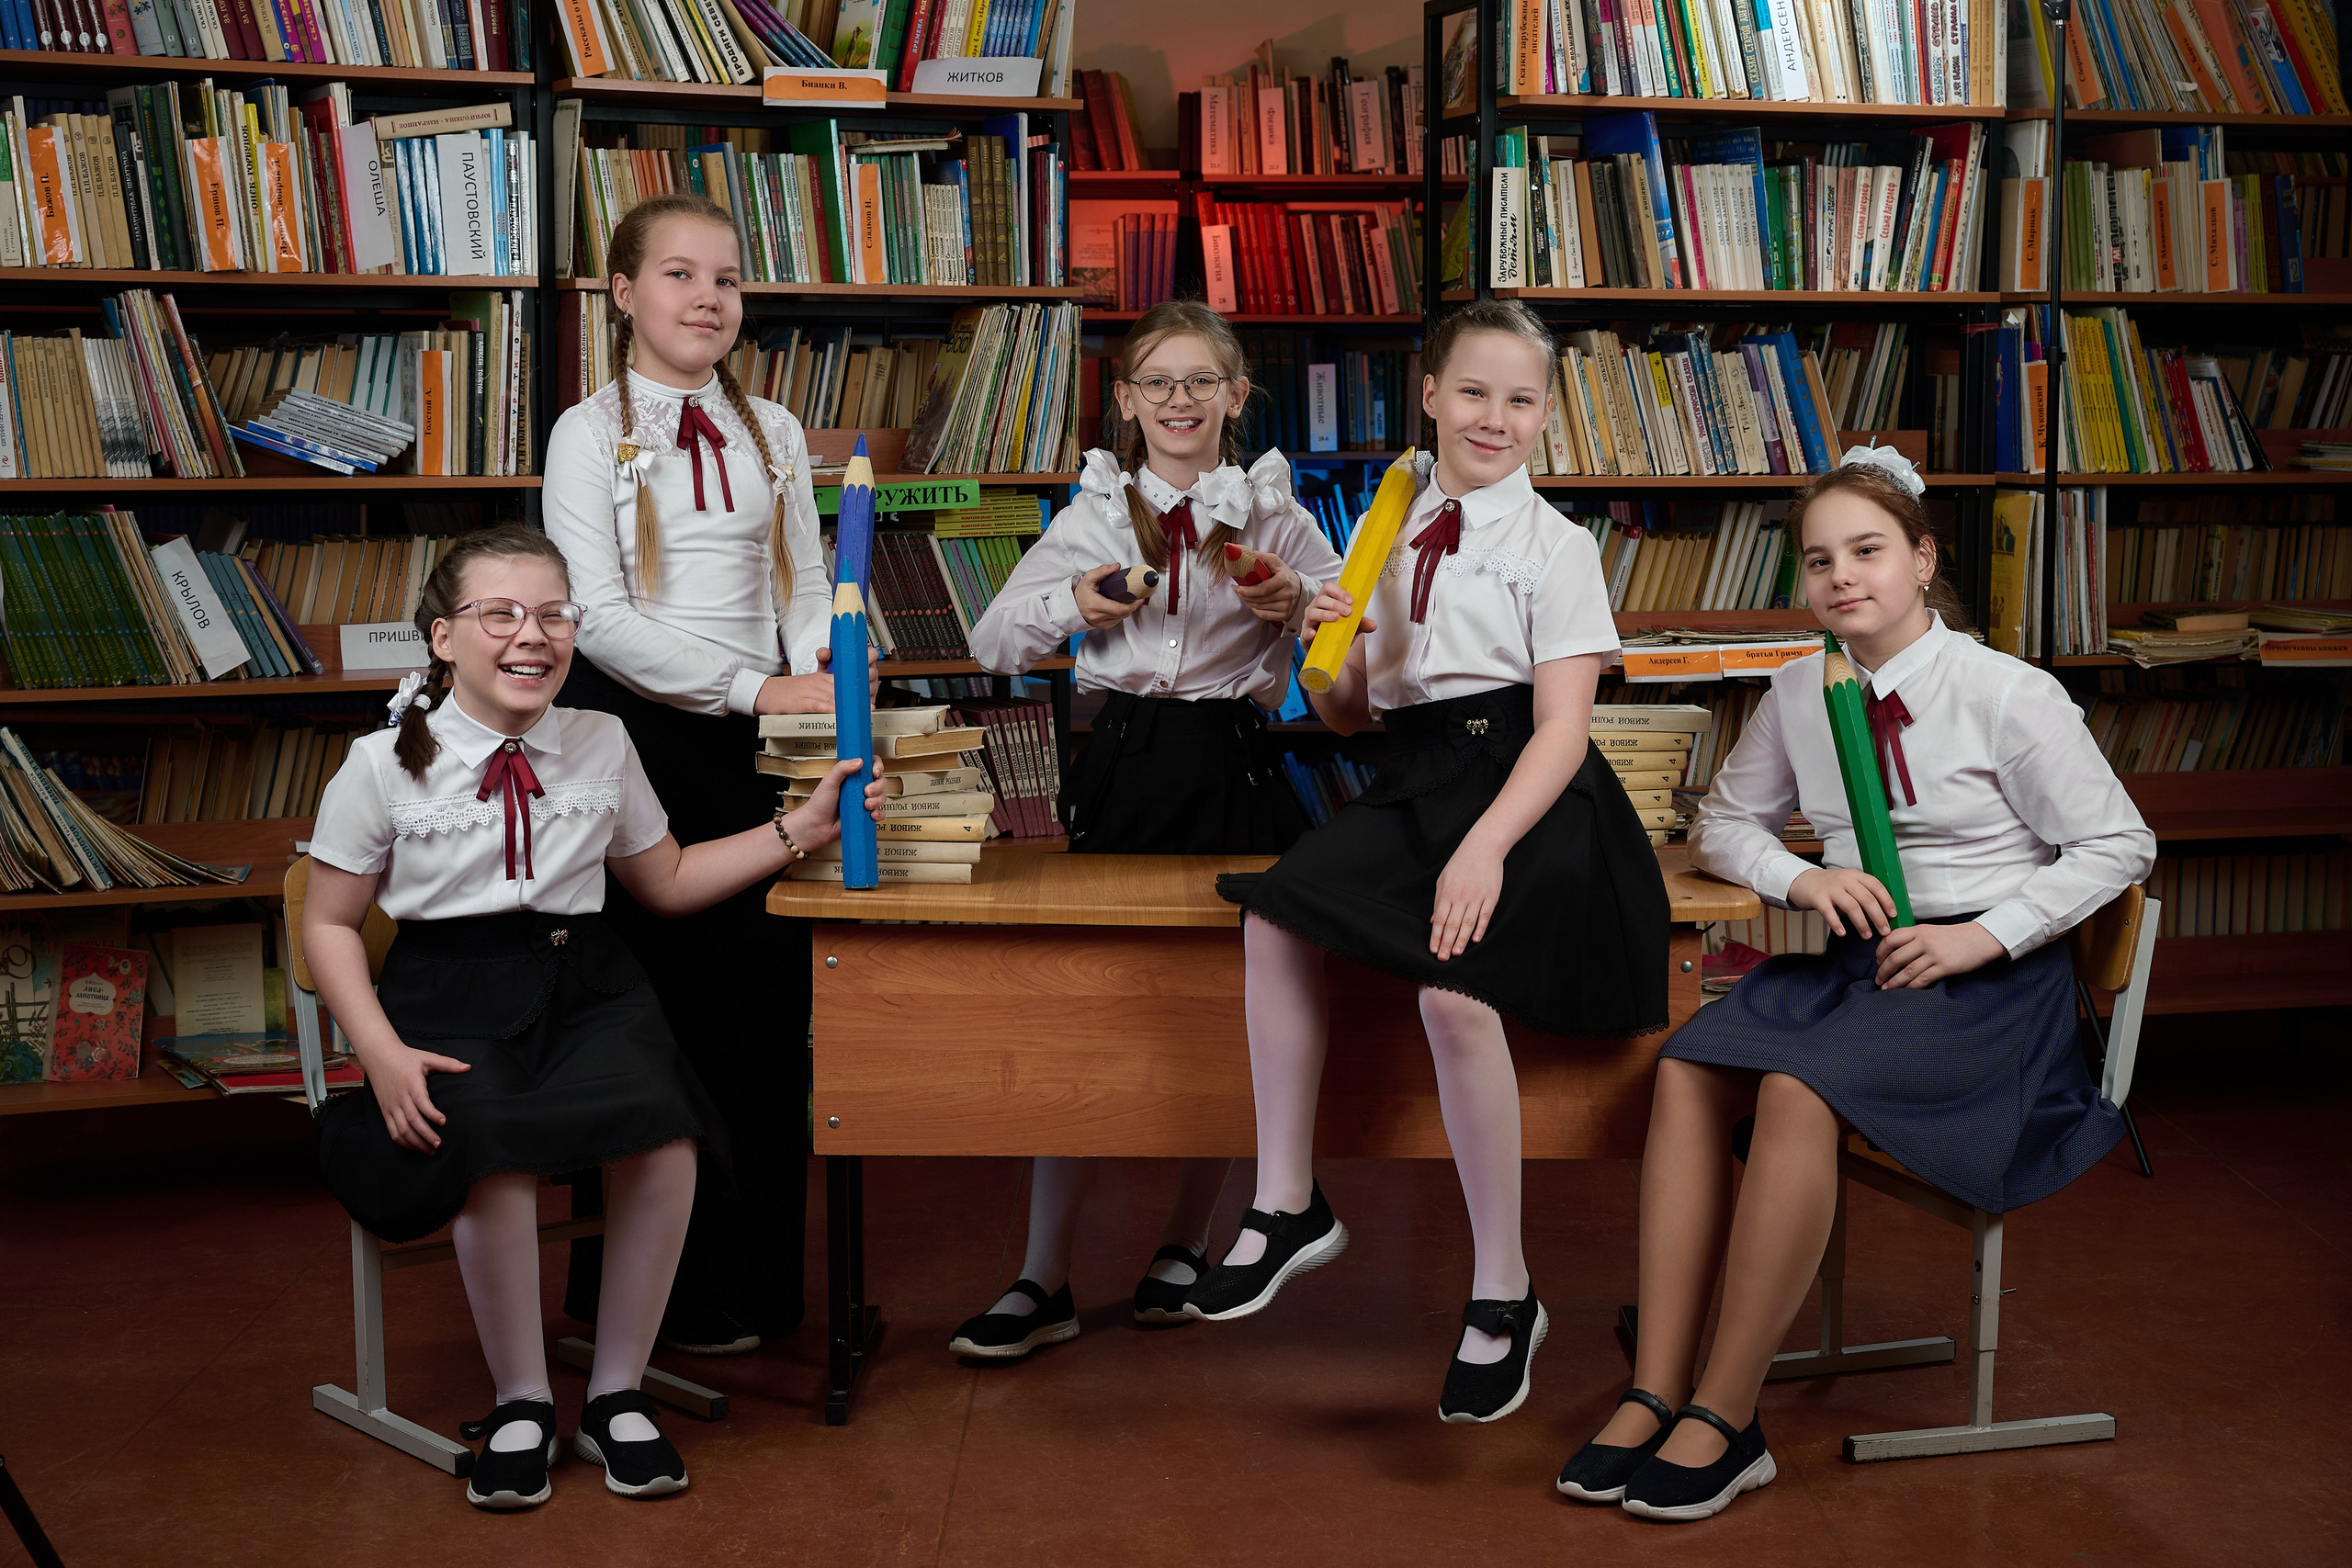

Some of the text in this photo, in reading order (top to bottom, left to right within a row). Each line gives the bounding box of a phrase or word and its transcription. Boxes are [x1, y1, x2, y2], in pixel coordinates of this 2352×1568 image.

[198, 3, 207, 29] СКАЗКИ
[209, 3, 219, 29] СКАЗКИ
[1930, 2, 1940, 47] СТРАНА
[1951, 5, 1959, 45] СТРАНА
[577, 14, 593, 59] Рассказы
[719, 28, 745, 76] БРОДЯГИ
[912, 18, 923, 53] ВРЕМЕНА
[1566, 13, 1575, 57] ВОЛШЕБНЫЙ
[1776, 0, 1797, 71] АНДЕРСЕН
[2182, 36, 2199, 62] Барто
[1518, 52, 1528, 86] Сказки
[1741, 26, 1759, 84] СКАЗКИ СТАРОЙ
[2073, 39, 2086, 83] Сборники
[801, 79, 848, 91] Бианки В.
[947, 72, 1004, 83] ЖИТКОВ
[399, 111, 492, 130] ЮРИЙ ОЛЕША ИЗБРАННОЕ
[1208, 94, 1218, 155] Математика
[1266, 107, 1276, 145] Физика
[1361, 92, 1373, 145] География
[40, 172, 55, 218] Бажов П.
[210, 182, 220, 217] Ершов
[368, 160, 386, 216] ОЛЕША
[864, 197, 872, 209] Н.
[1595, 169, 1605, 204] МАУГЛИ
[1639, 176, 1648, 210] КИПЛИНГ
[461, 152, 486, 260] ПАУСТОВСКИЙ
[1855, 183, 1871, 239] Сельма Лагерлёф
[1878, 182, 1897, 239] Сельма Лагерлёф
[1498, 172, 1509, 283] ЗАРУБЕЖНЫЕ ПИСАТЕЛИ
[2027, 208, 2036, 262] С. Маршак
[2157, 200, 2169, 271] В. Маяковский
[2210, 206, 2218, 267] С. Михалков
[1212, 234, 1223, 282] Биология
[1273, 293, 1282, 304] 2
[1287, 295, 1295, 306] 3
[1680, 357, 1693, 383] СКАЗКИ
[424, 387, 432, 396] А.
[1316, 371, 1326, 424] Животные
[2035, 384, 2046, 448] К. Чуковский
[874, 485, 969, 506] РУЖИТЬ
[171, 570, 211, 631] КРЫЛОВ
[1648, 656, 1690, 665] Андерсен Г.
[1746, 649, 1803, 659] братья Гримм
[2265, 643, 2317, 653] Почемучкины
[798, 721, 836, 731] РОДНИК
[1618, 716, 1650, 726] ЖИВОЙ
[794, 740, 821, 750] РОДНИК
[1609, 739, 1638, 747] ЖИВОЙ
[910, 802, 940, 810] ЖИВОЙ
[889, 823, 922, 833] ЖИВОЙ
[885, 848, 918, 857] ЖИВОЙ
